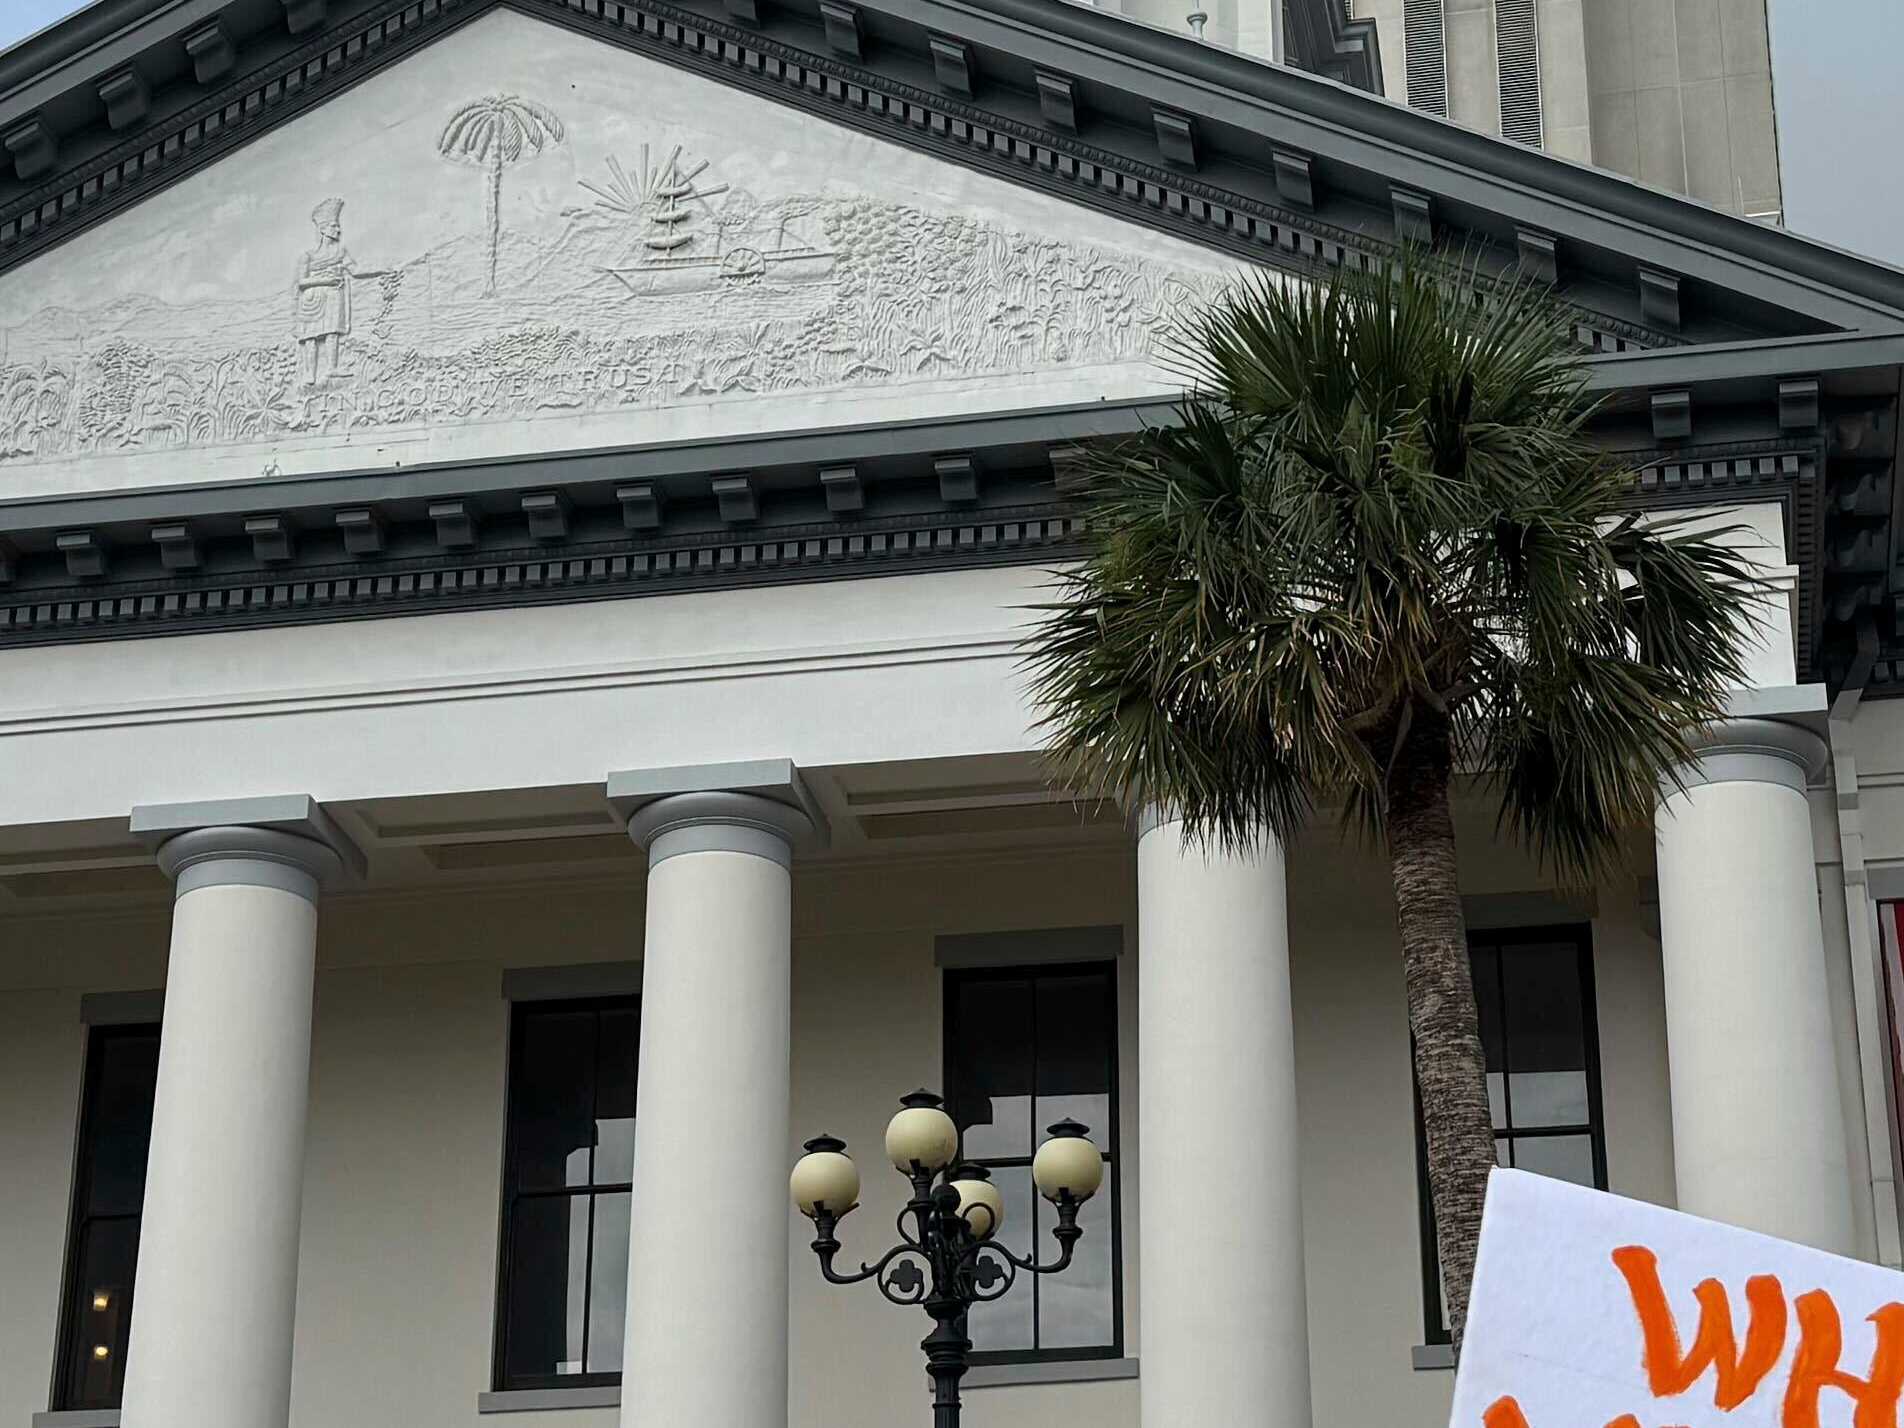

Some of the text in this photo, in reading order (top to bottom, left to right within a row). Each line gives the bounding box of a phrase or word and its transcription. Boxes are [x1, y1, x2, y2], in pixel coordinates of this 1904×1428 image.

[322, 362, 688, 412] IN GOD WE TRUST
